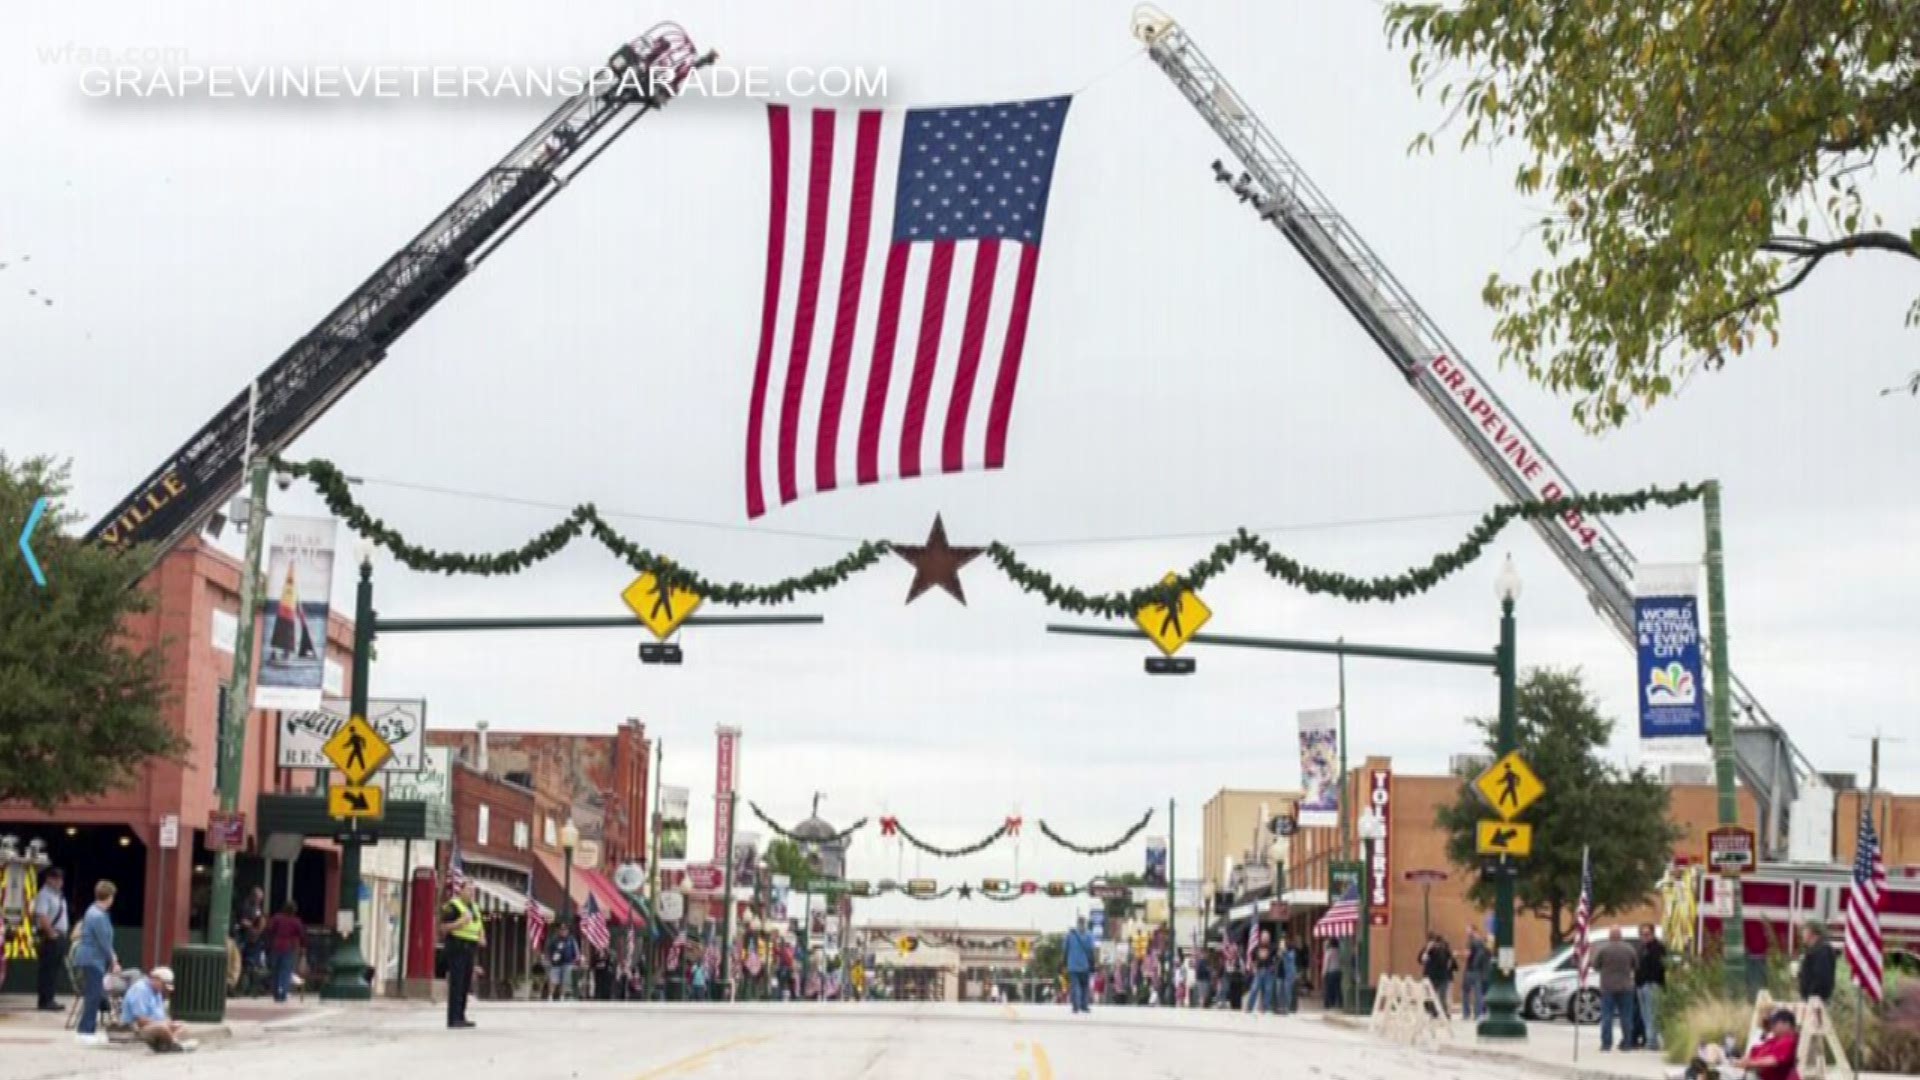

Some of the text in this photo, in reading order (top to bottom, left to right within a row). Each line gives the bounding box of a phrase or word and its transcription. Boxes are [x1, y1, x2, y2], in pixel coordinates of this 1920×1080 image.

[1432, 355, 1543, 480] GRAPEVINE
[1642, 607, 1692, 620] WORLD
[1638, 620, 1694, 633] FESTIVAL
[1640, 631, 1697, 646] & EVENT
[1654, 645, 1685, 658] CITY
[720, 736, 731, 793] CITY
